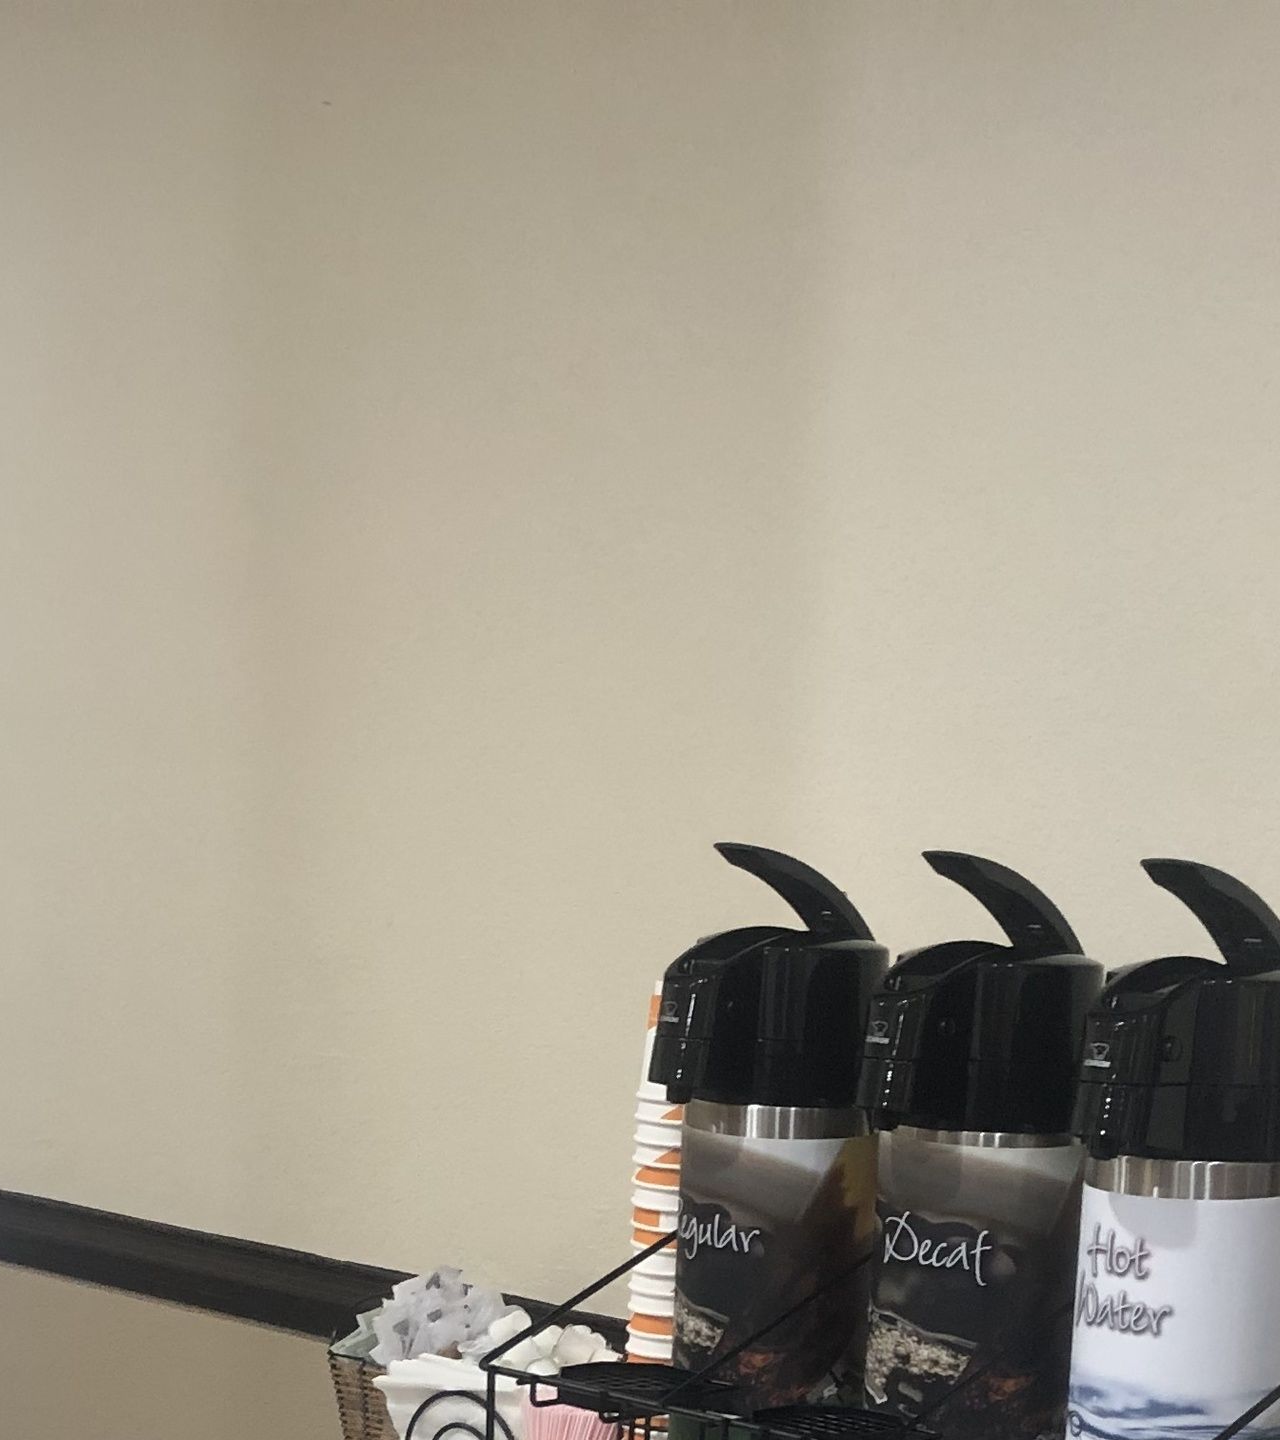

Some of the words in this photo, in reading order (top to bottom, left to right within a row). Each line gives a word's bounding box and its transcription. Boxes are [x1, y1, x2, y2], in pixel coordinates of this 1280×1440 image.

[679, 1200, 761, 1260] egular
[883, 1210, 993, 1287] Decaf
[1086, 1221, 1151, 1280] Hot
